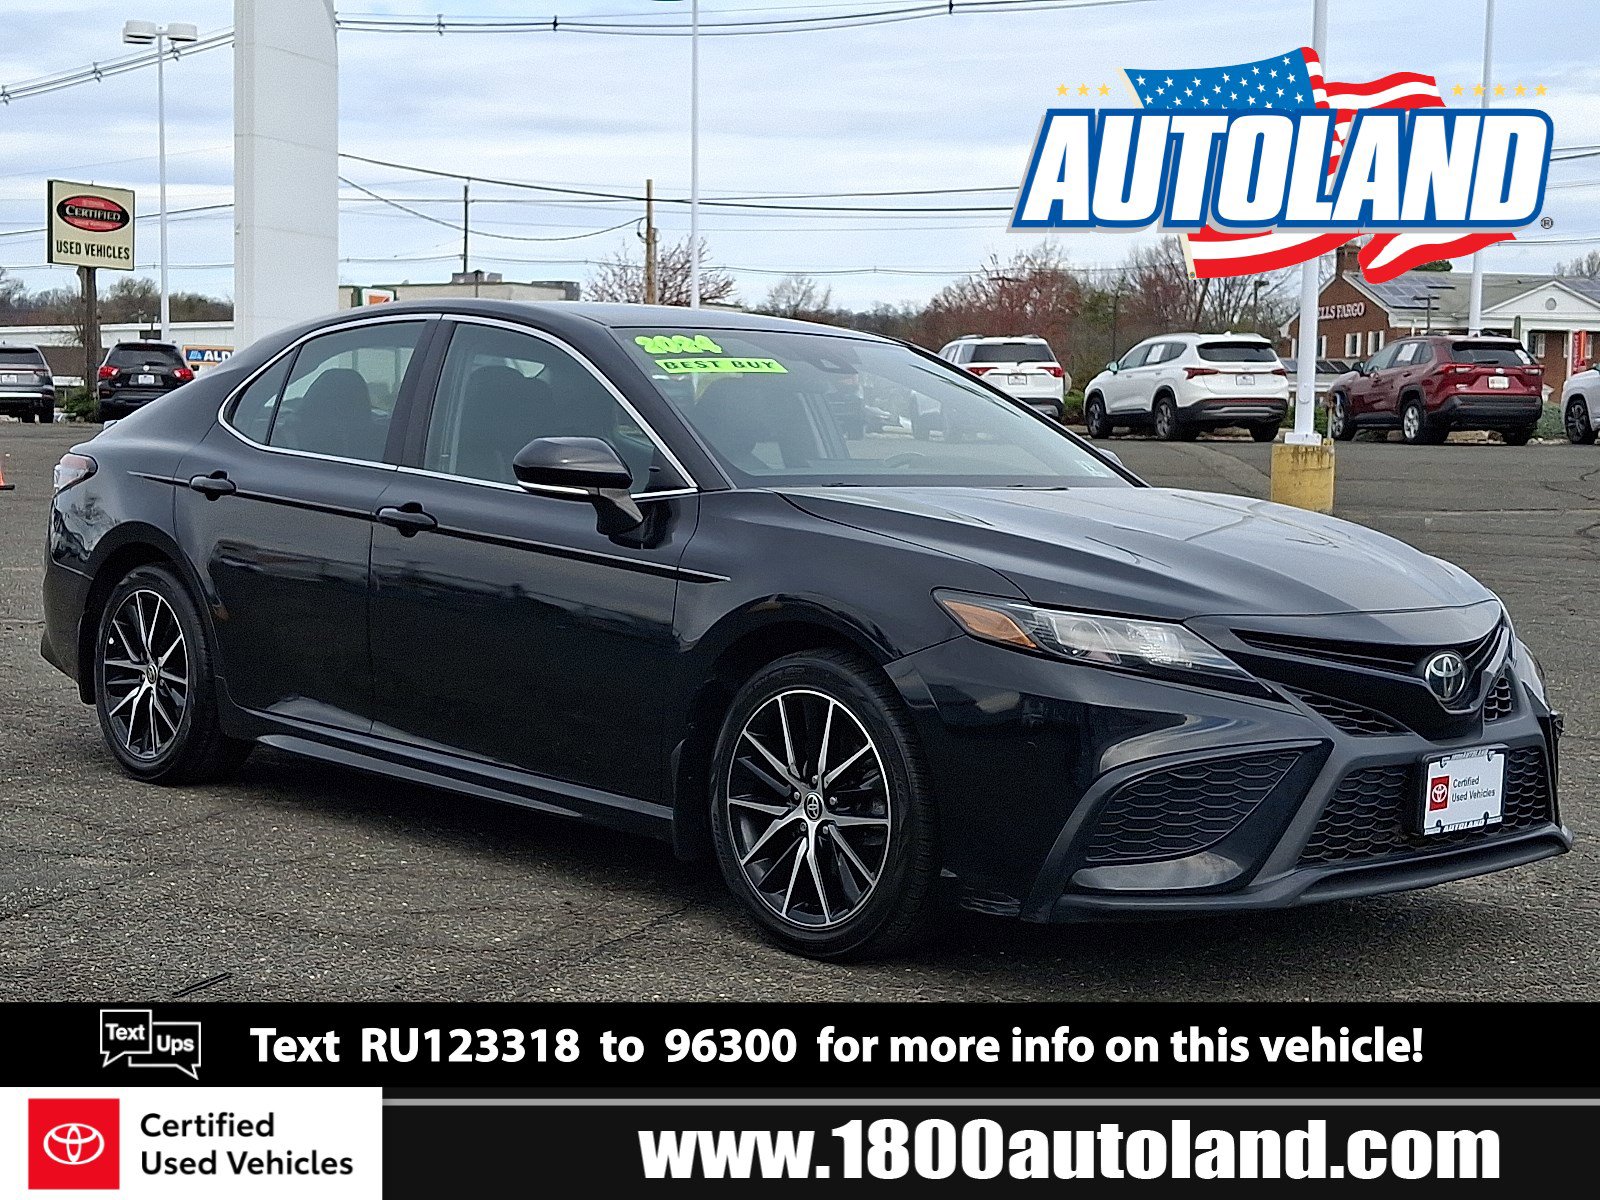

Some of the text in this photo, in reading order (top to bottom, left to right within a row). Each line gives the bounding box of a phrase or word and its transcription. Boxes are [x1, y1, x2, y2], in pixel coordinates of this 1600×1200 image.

[56, 240, 130, 260] USED VEHICLES
[1319, 305, 1336, 320] LLS
[203, 350, 235, 361] ALD
[664, 360, 774, 370] BEST BUY
[1452, 775, 1480, 789] Certified
[1451, 788, 1496, 802] Used Vehicles
[1442, 819, 1485, 833] AUTOLAND
